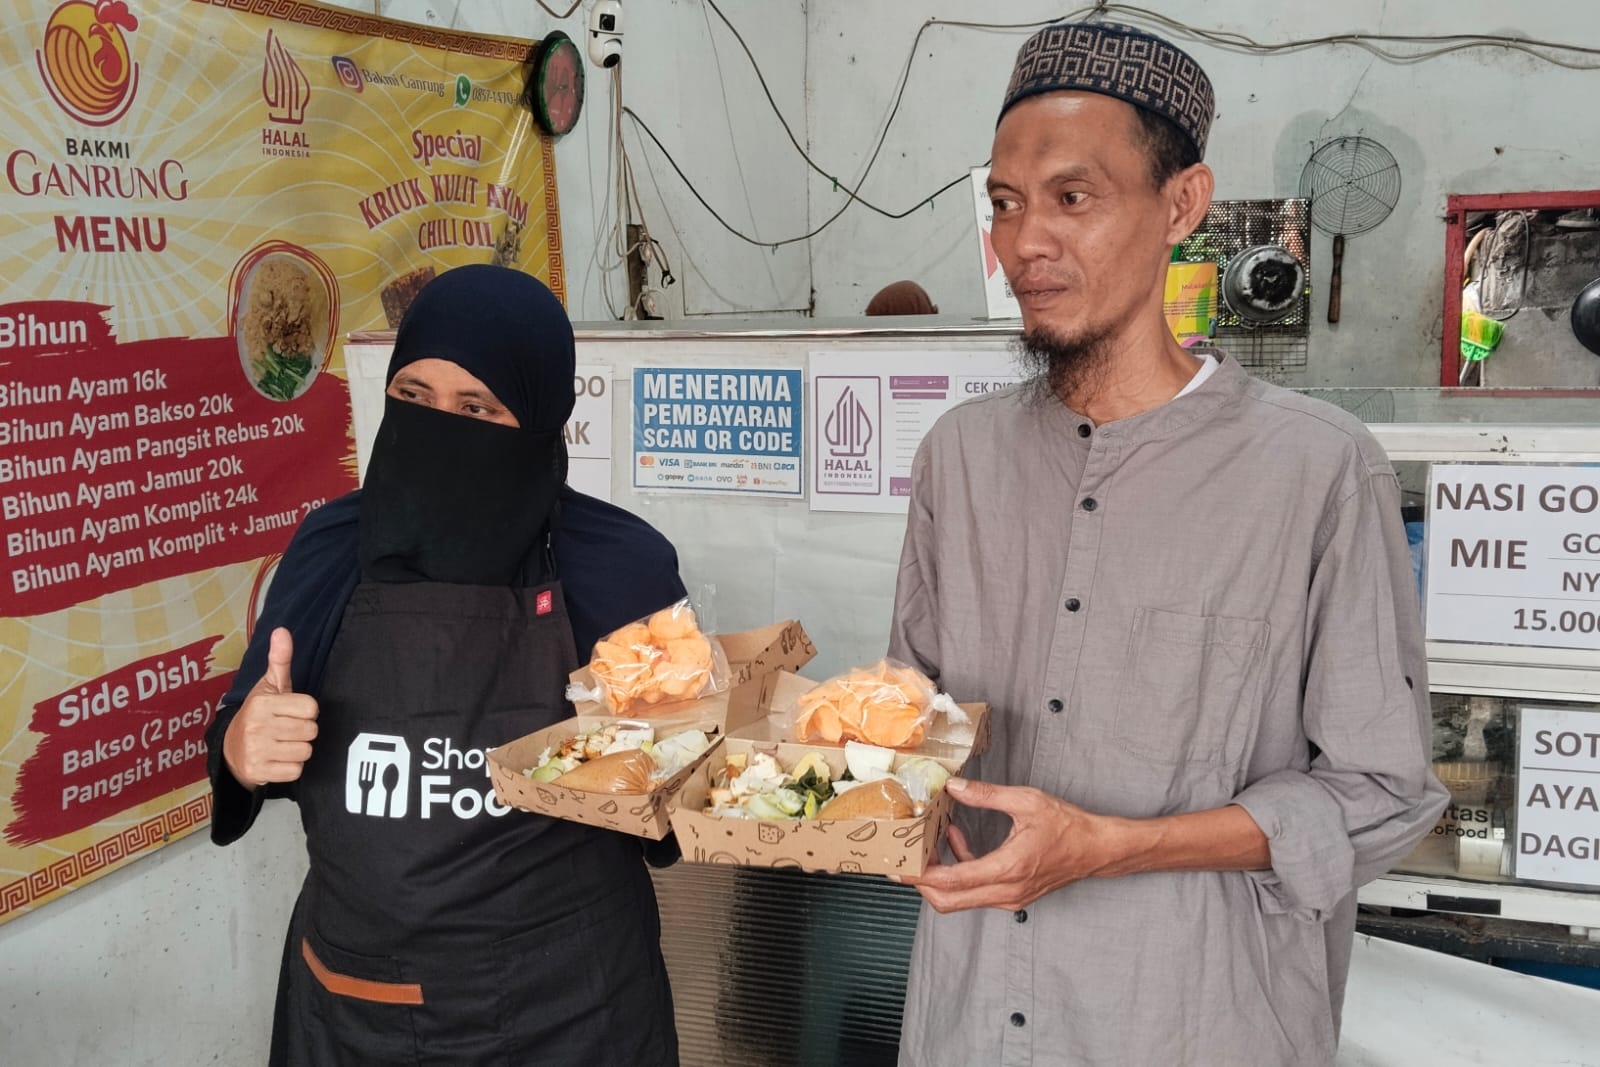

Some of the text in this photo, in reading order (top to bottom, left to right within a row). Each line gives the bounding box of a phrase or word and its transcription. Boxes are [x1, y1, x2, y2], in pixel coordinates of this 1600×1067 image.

[361, 69, 445, 98] Bakmi Ganrung
[66, 138, 130, 159] BAKMI
[262, 128, 310, 148] HALAL
[262, 147, 311, 158] INDONESIA
[412, 130, 482, 166] Special
[6, 149, 189, 201] GANRUNG
[358, 177, 428, 230] KRIUK
[431, 174, 478, 204] KULIT
[54, 215, 167, 253] MENU
[418, 219, 495, 251] CHILI OIL
[0, 313, 87, 348] Bihun
[0, 368, 168, 408] Bihun Ayam 16k
[643, 373, 792, 402] MENERIMA
[964, 382, 989, 393] CEK
[0, 393, 234, 446] Bihun Ayam Bakso 20k
[644, 403, 793, 429] PEMBAYARAN
[0, 413, 305, 483] Bihun Ayam Pangsit Rebus 20k
[643, 429, 793, 452] SCAN QR CODE
[659, 458, 680, 467] VISA
[824, 459, 873, 471] HALAL
[2, 455, 244, 520] Bihun Ayam Jamur 20k
[1436, 483, 1599, 514] NASI GO
[7, 483, 259, 557] Bihun Ayam Komplit 24k
[12, 561, 81, 594] Bihun
[86, 547, 145, 578] Ayam
[148, 523, 226, 559] Komplit
[229, 522, 239, 536] +
[243, 508, 299, 536] Jamur
[1450, 538, 1528, 570] MIE
[1562, 533, 1600, 554] GO
[1562, 571, 1600, 593] NY
[1513, 608, 1600, 633] 15.00
[58, 654, 200, 728] Side Dish
[62, 733, 136, 776] Bakso
[141, 718, 163, 749] (2
[168, 700, 211, 740] pcs)
[1534, 730, 1600, 758] SOT
[421, 737, 499, 778] Sho
[61, 739, 208, 811] Pangsit Rebu
[421, 775, 513, 820] Foo
[1526, 783, 1599, 812] AYA
[1429, 824, 1488, 839] oFood
[1520, 832, 1599, 861] DAGI
